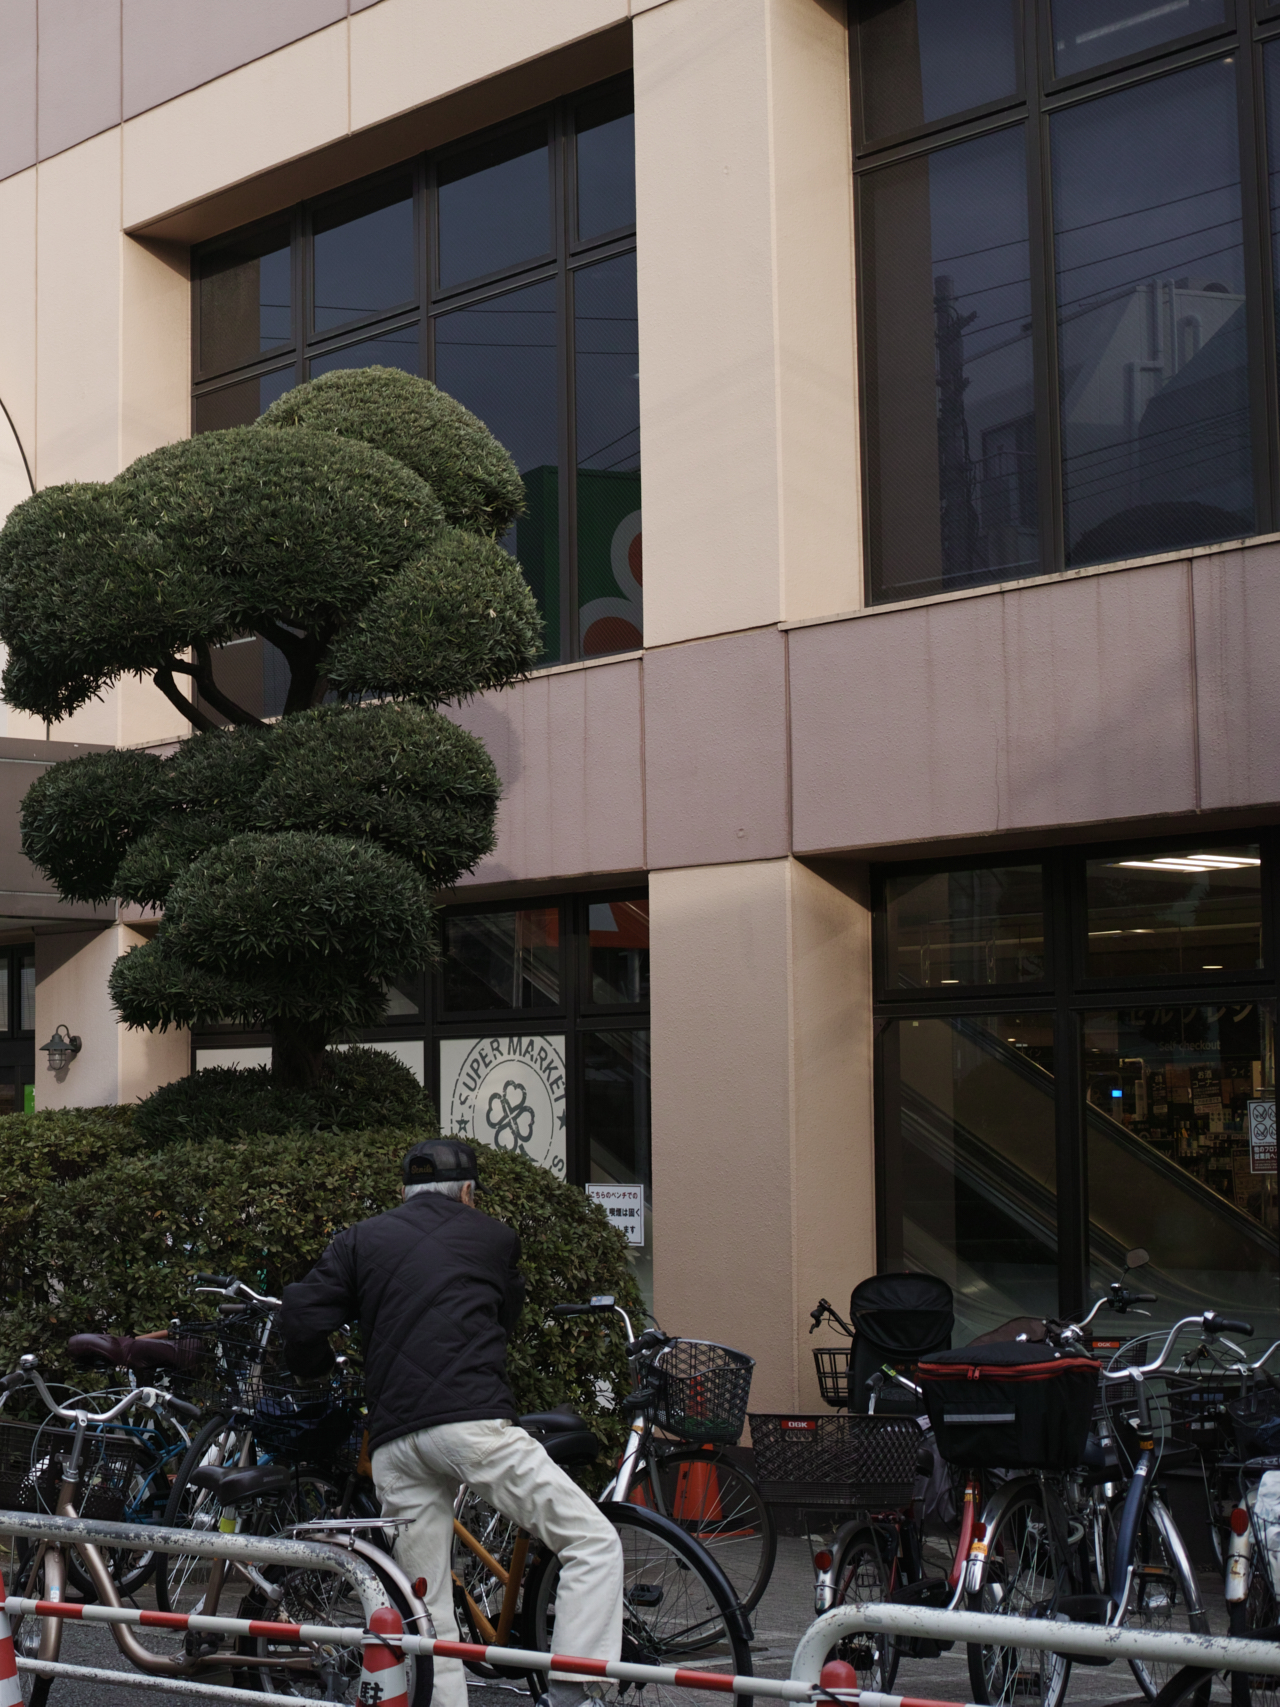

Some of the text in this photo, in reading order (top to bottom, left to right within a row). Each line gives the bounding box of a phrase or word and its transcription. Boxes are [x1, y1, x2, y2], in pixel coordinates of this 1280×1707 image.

[458, 1036, 567, 1109] SUPER MARKET
[590, 1191, 638, 1200] こちらのベンチでの
